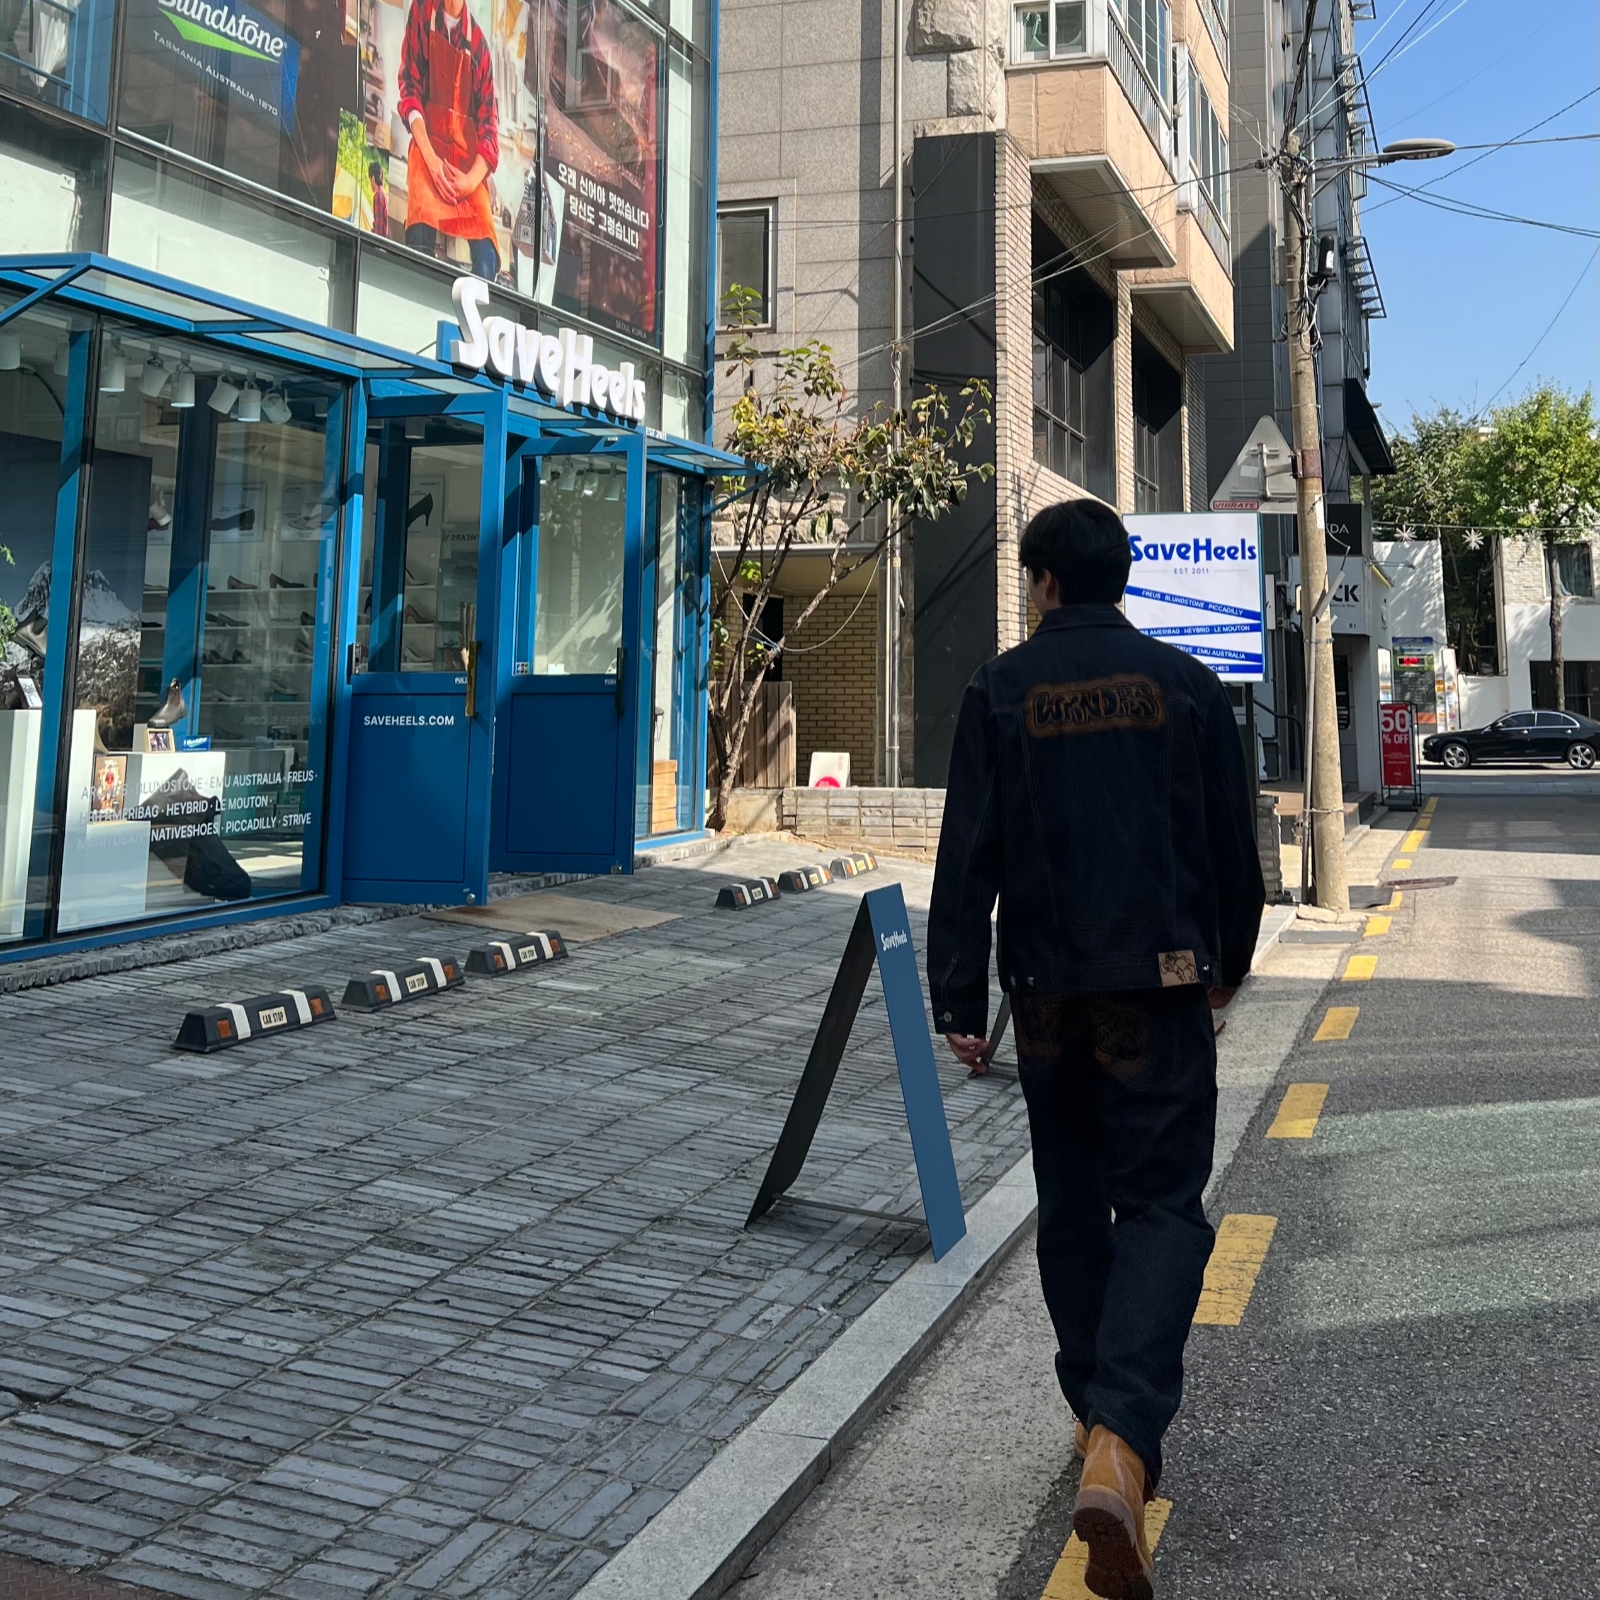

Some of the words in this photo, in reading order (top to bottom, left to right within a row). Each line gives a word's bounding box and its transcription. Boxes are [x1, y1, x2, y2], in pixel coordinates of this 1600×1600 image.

[153, 30, 202, 69] TASMANIA
[558, 162, 577, 190] 오래
[580, 175, 605, 206] 신어야
[609, 191, 650, 230] 멋있습니다
[569, 194, 595, 226] 당신도
[598, 210, 639, 249] 그렇습니다
[632, 326, 647, 340] KOREA
[450, 276, 646, 421] SaveHeels
[645, 426, 656, 437] EST
[655, 429, 667, 441] 2011
[1326, 523, 1349, 534] DA
[1127, 535, 1257, 564] SaveHeels
[1141, 590, 1161, 600] FREUS
[1164, 594, 1205, 609] BLUNDSTONE
[1208, 603, 1244, 616] PICCADILLY
[1184, 626, 1210, 634] HEYBRID
[1214, 625, 1221, 633] LE
[1223, 624, 1251, 632] MOUTON
[1196, 648, 1211, 656] EMU
[1211, 650, 1246, 660] AUSTRALIA
[363, 715, 455, 726] SAVEHEELS.COM
[1381, 709, 1409, 733] 50
[1382, 733, 1391, 744] %
[1393, 733, 1409, 744] OFF
[138, 777, 203, 796] BLUNDSTONE
[209, 775, 231, 789] EMU
[232, 773, 282, 787] AUSTRALIA
[287, 769, 314, 783] FREUS
[166, 800, 209, 816] HEYBRID
[215, 798, 226, 812] LE
[228, 795, 269, 810] MOUTON
[150, 821, 219, 842] NATIVESHOES
[225, 818, 277, 834] PICCADILLY
[282, 812, 312, 827] STRIVE
[408, 979, 416, 990] CAR
[416, 976, 425, 987] STOP
[262, 1014, 272, 1025] CAR
[273, 1011, 284, 1022] STOP
